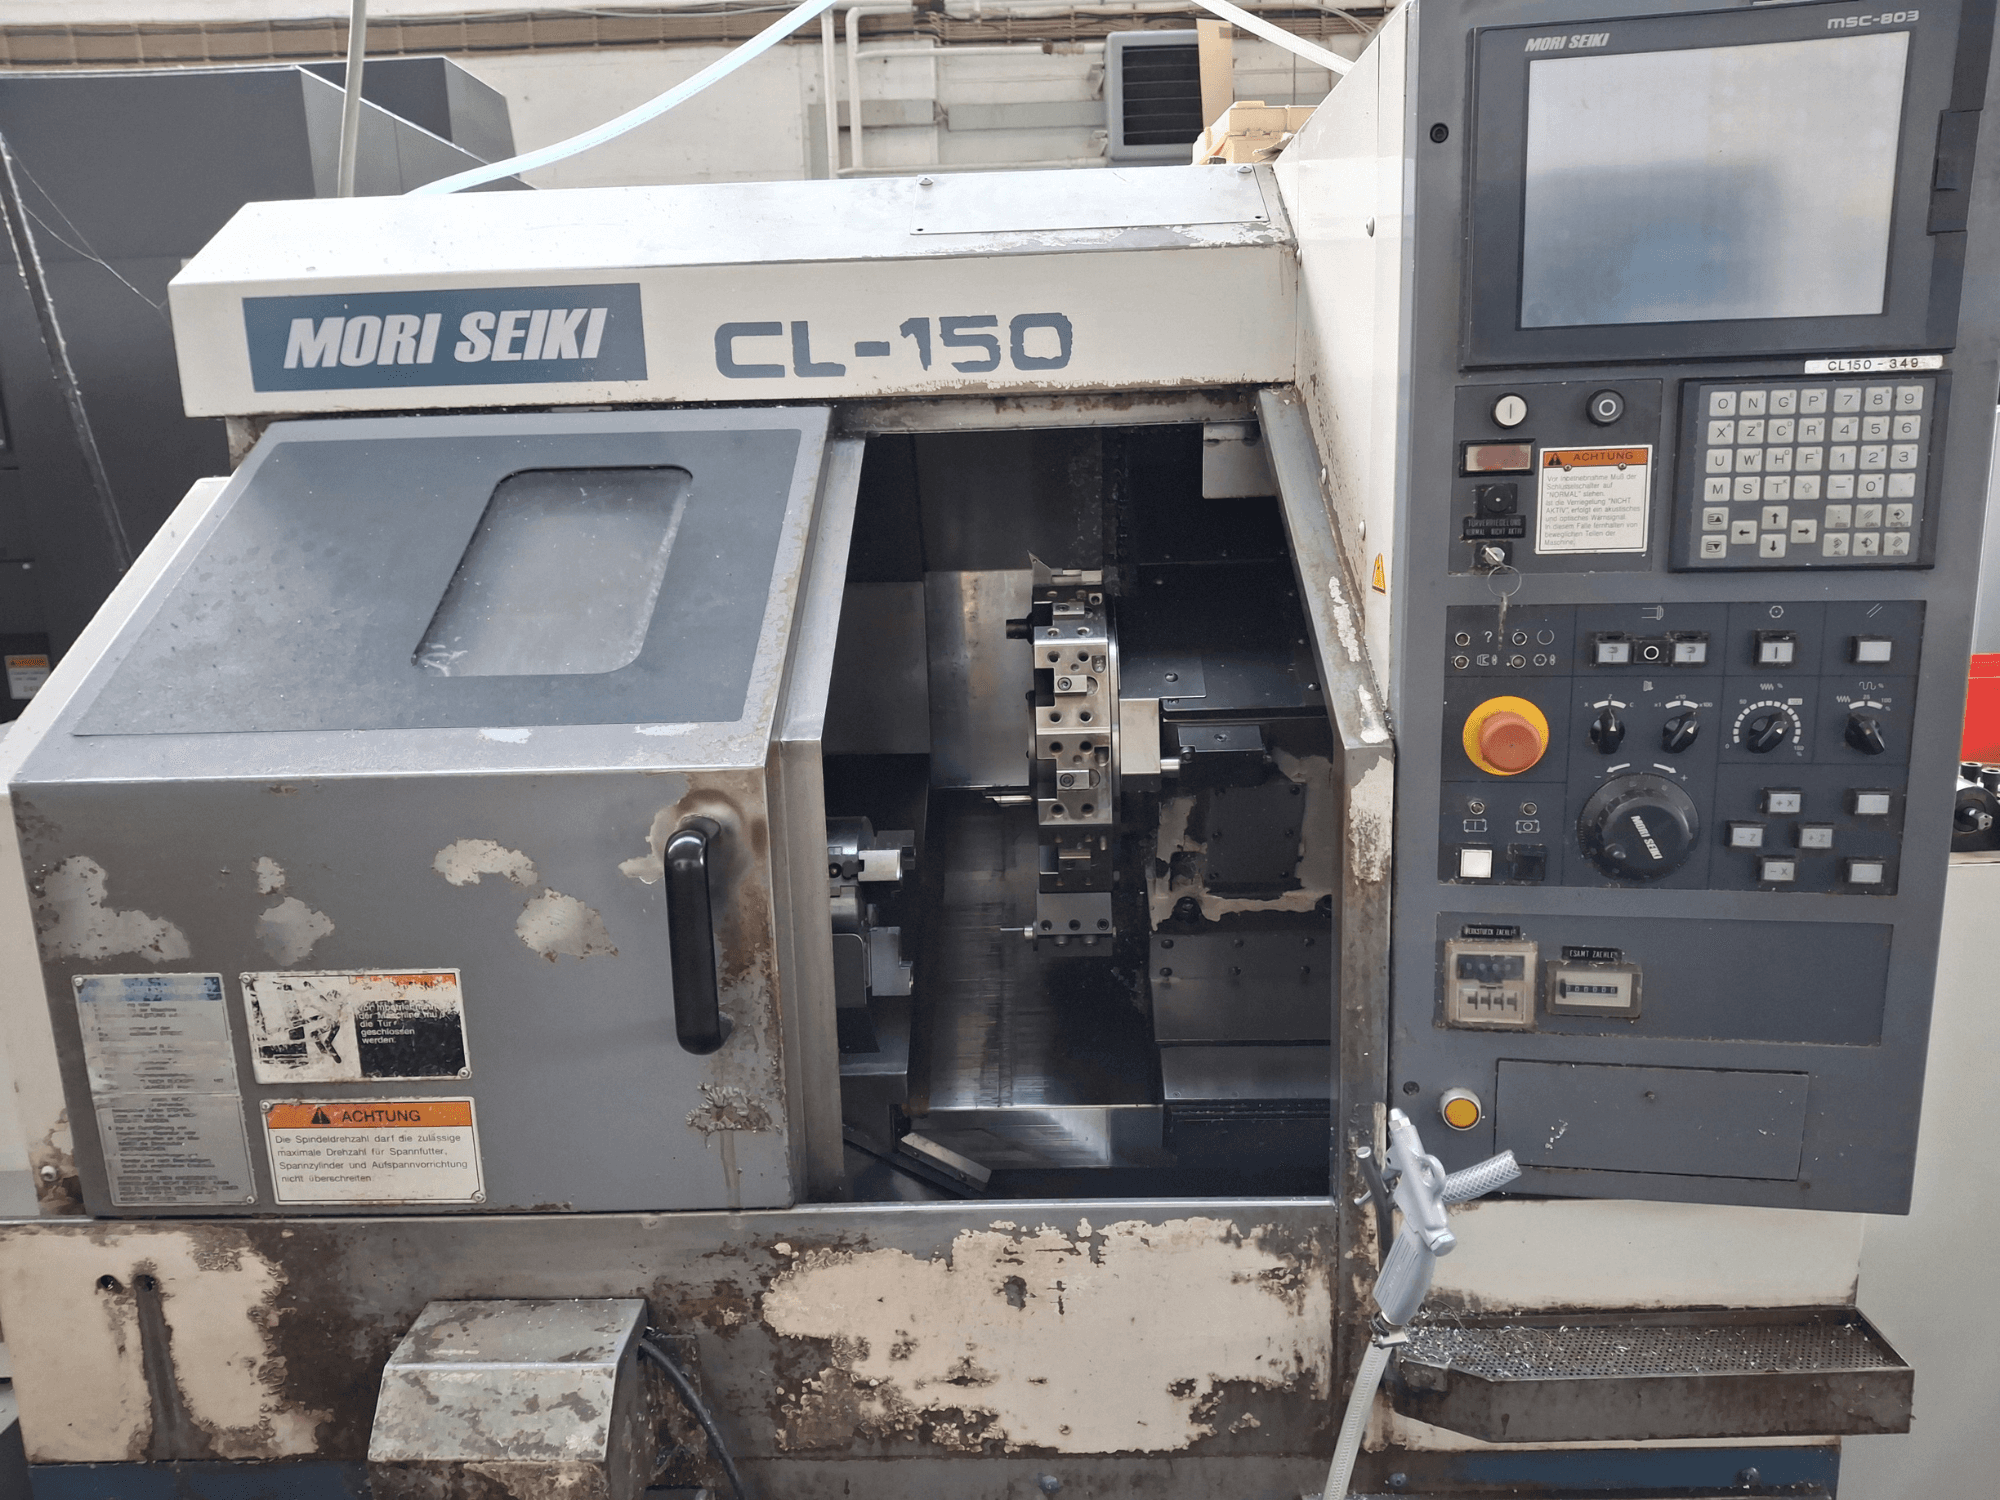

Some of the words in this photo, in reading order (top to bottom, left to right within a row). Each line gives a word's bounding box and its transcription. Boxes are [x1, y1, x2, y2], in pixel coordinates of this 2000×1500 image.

[1524, 36, 1567, 52] MORI
[1568, 33, 1610, 48] SEIKI
[284, 313, 442, 369] MORI
[454, 308, 608, 362] SEIKI
[714, 312, 1072, 378] CL-150
[1828, 360, 1872, 370] CL150
[1889, 358, 1919, 369] 349
[1718, 398, 1728, 409] O
[1748, 398, 1758, 408] N
[1778, 397, 1789, 407] G
[1809, 396, 1818, 406] P
[1843, 395, 1853, 405] 7
[1873, 394, 1883, 405] 8
[1904, 394, 1914, 404] 9
[1747, 426, 1755, 436] Z
[1776, 426, 1786, 436] C
[1806, 425, 1816, 435] R
[1840, 425, 1849, 435] 4
[1871, 424, 1880, 434] 5
[1902, 422, 1912, 433] 6
[1717, 428, 1726, 438] X
[1573, 452, 1634, 461] ACHTUNG
[1715, 456, 1724, 466] U
[1744, 455, 1755, 465] W
[1775, 454, 1784, 464] H
[1805, 454, 1814, 464] F
[1840, 453, 1845, 463] 1
[1869, 452, 1878, 463] 2
[1899, 451, 1908, 462] 3
[1712, 484, 1723, 494] M
[1743, 484, 1752, 494] S
[1773, 483, 1782, 493] T
[1572, 507, 1591, 515] erfolgt
[1560, 514, 1588, 522] optisches
[1631, 816, 1651, 838] MORI
[1644, 838, 1663, 859] SEIKI
[361, 1028, 415, 1037] geschlossen
[342, 1110, 420, 1123] ACHTUNG
[276, 1136, 291, 1144] Die
[295, 1135, 369, 1144] Spindeldrehzahl
[374, 1134, 395, 1143] darf
[399, 1134, 413, 1143] die
[418, 1133, 461, 1144] zulässige
[277, 1148, 321, 1157] maximale
[326, 1148, 367, 1156] Drehzahl
[279, 1161, 344, 1171] Spannzylinder
[349, 1161, 366, 1169] und
[372, 1160, 468, 1170] Aufspannvorrichtung
[281, 1175, 303, 1183] nicht
